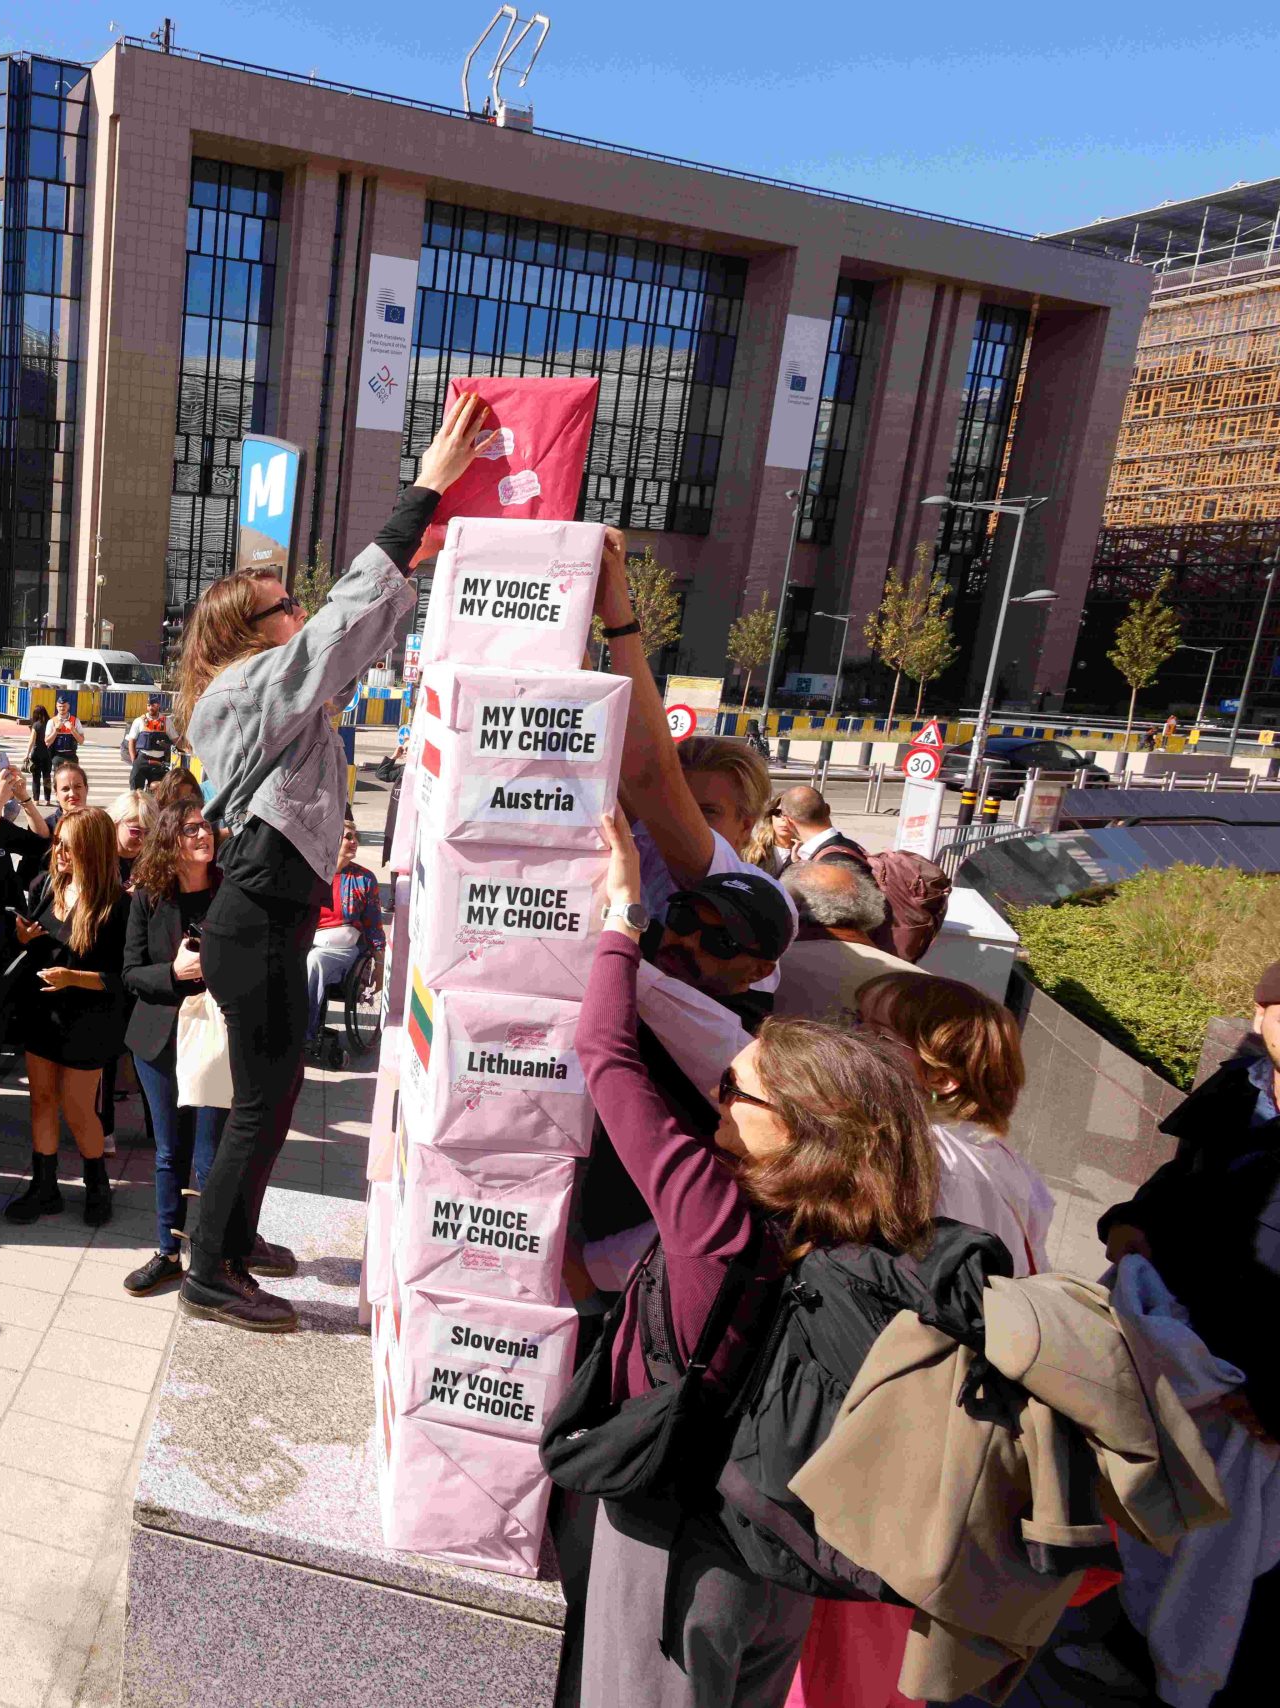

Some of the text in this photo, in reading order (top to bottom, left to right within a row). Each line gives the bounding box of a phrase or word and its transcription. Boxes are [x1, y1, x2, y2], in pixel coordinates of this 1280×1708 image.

[247, 452, 288, 523] M
[462, 578, 551, 601] MY VOICE
[459, 598, 561, 622] MY CHOICE
[482, 706, 583, 729] MY VOICE
[480, 730, 596, 753] MY CHOICE
[910, 758, 932, 774] 30
[490, 787, 574, 811] Austria
[469, 884, 568, 909] MY VOICE
[467, 906, 580, 932] MY CHOICE
[467, 1051, 568, 1080] Lithuania
[434, 1201, 528, 1231] MY VOICE
[432, 1221, 540, 1253] MY CHOICE
[451, 1326, 539, 1359] Slovenia
[432, 1368, 524, 1400] MY VOICE
[430, 1385, 535, 1422] MY CHOICE
